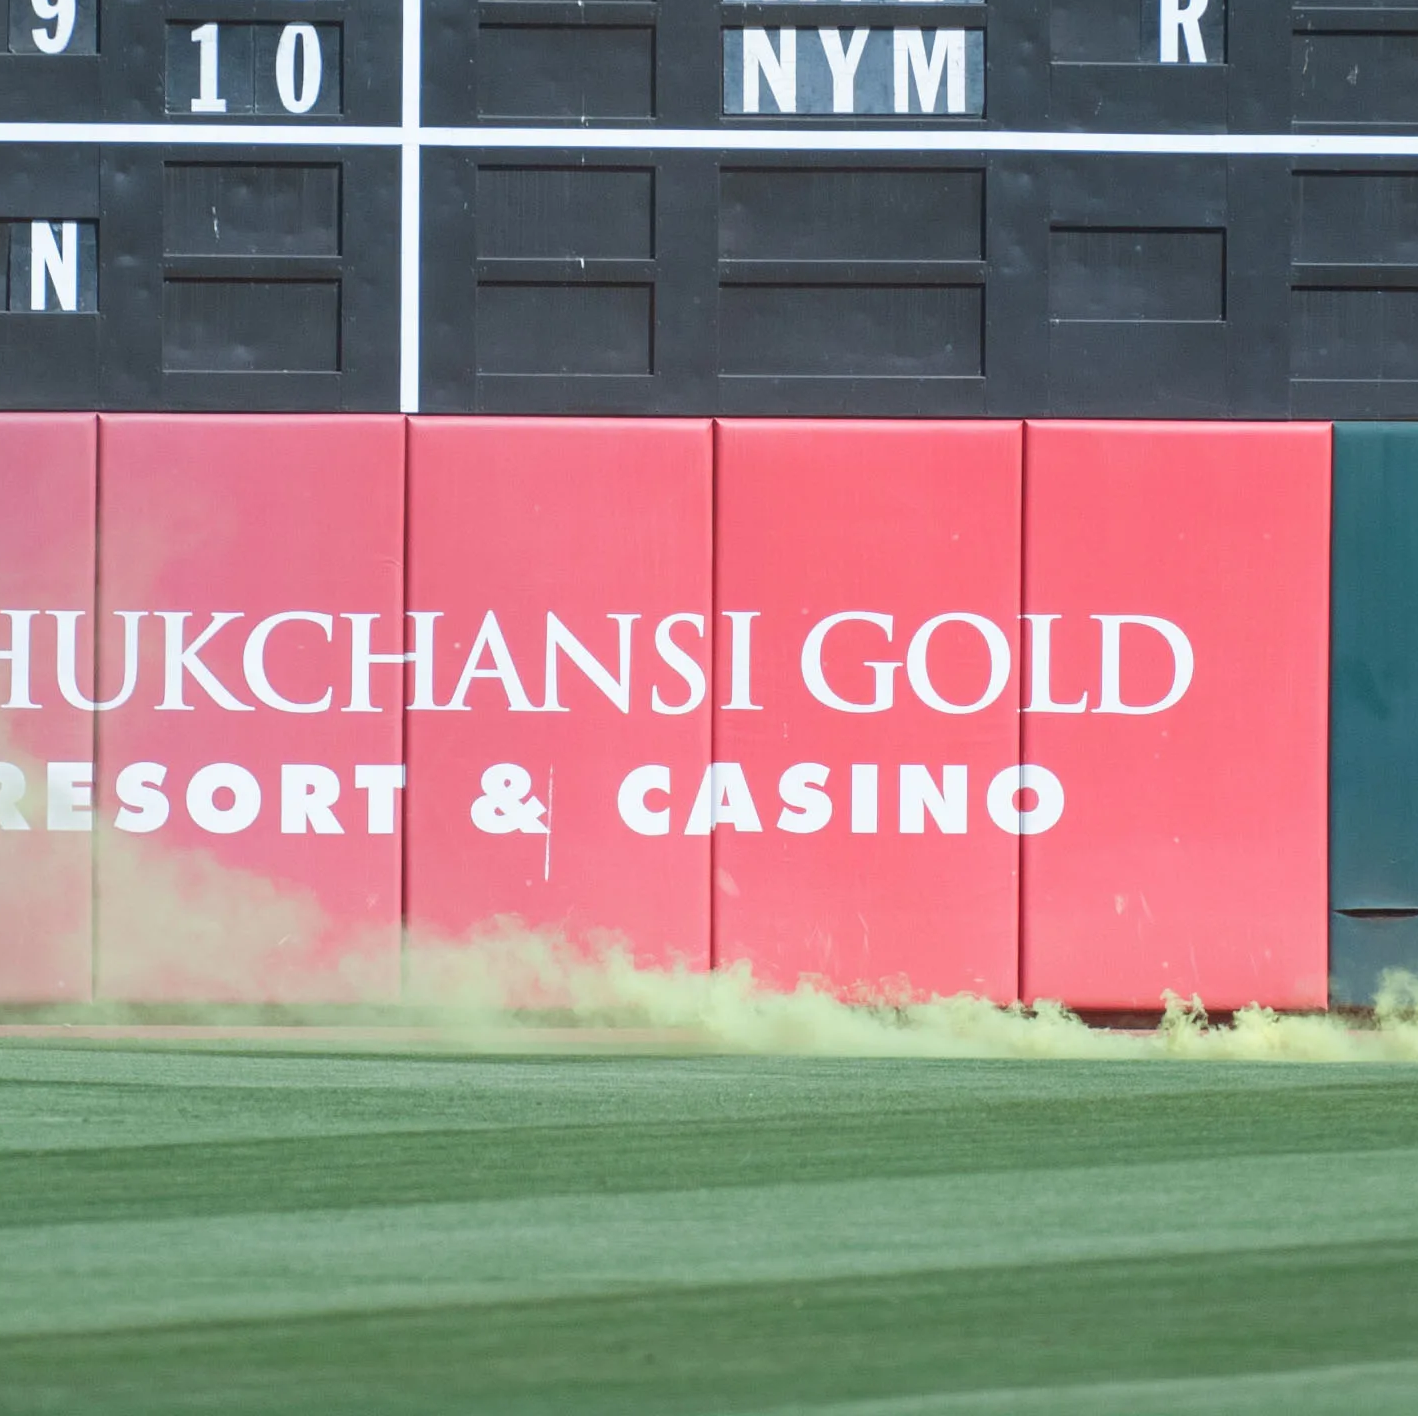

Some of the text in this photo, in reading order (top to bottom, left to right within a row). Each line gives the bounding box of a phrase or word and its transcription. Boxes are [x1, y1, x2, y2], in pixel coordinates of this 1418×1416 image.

[742, 27, 966, 114] NYM
[30, 221, 77, 312] N
[801, 611, 1194, 715] GOLD
[470, 762, 552, 835] &
[617, 762, 1066, 837] CASINO
